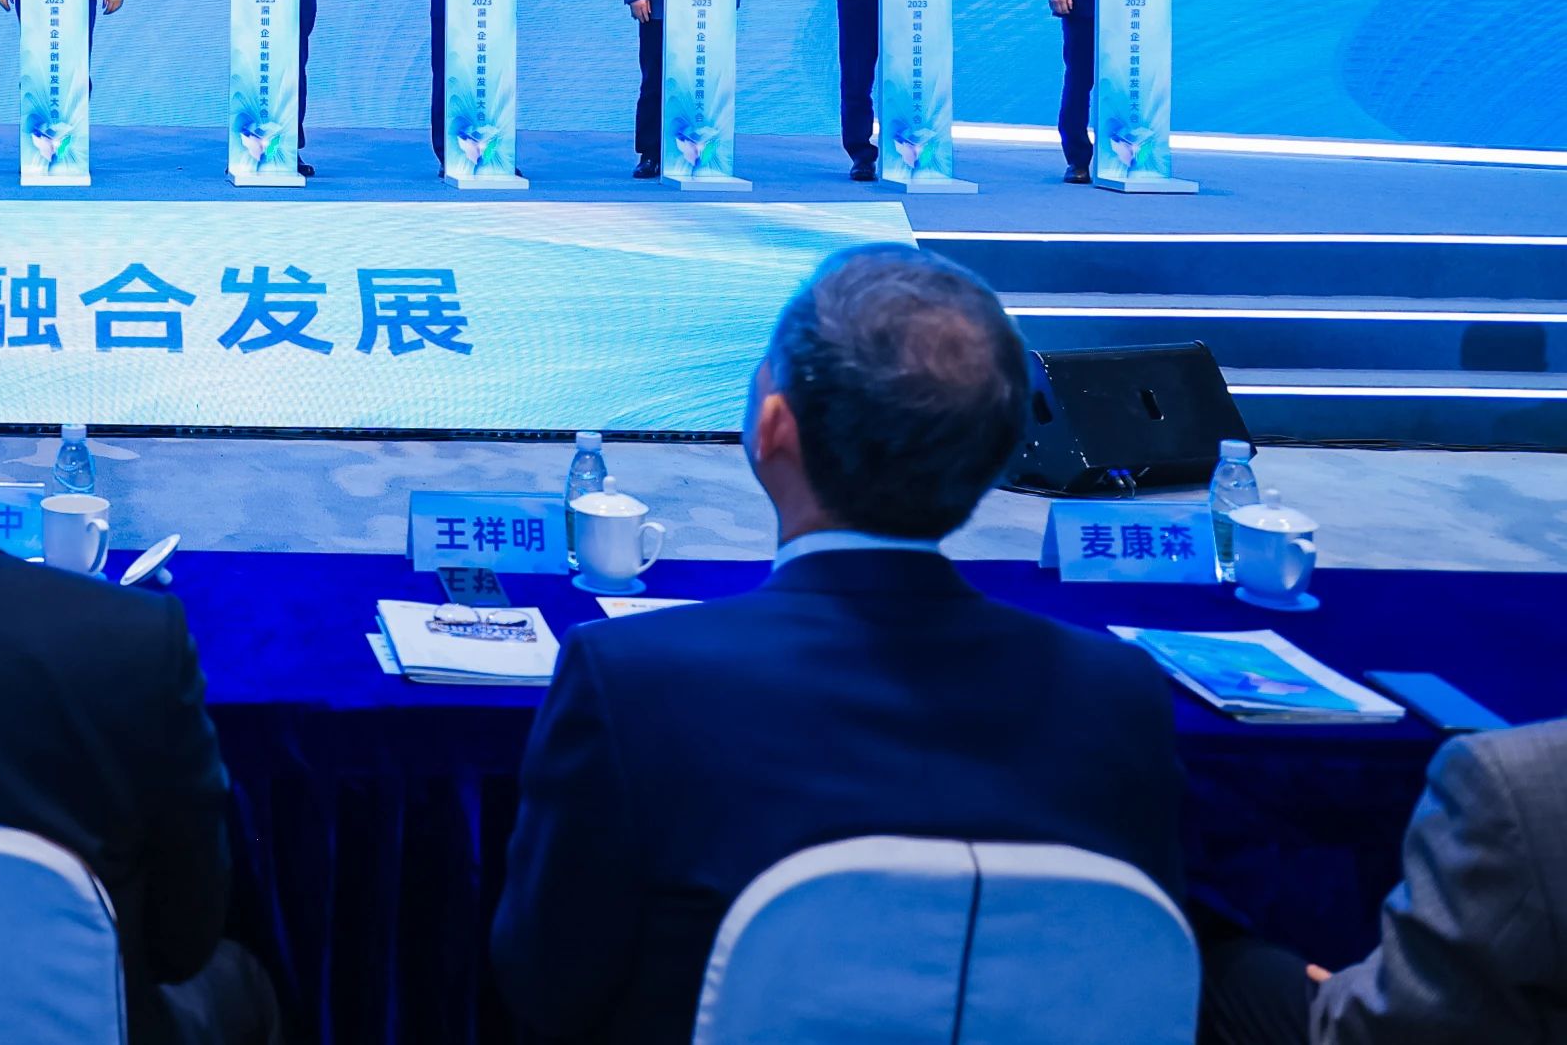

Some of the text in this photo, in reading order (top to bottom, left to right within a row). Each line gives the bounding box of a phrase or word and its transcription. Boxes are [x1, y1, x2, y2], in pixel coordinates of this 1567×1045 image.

[692, 0, 712, 7] 2023
[907, 0, 928, 8] 2023
[434, 515, 547, 552] 王祥明
[1080, 523, 1196, 561] 麦康森
